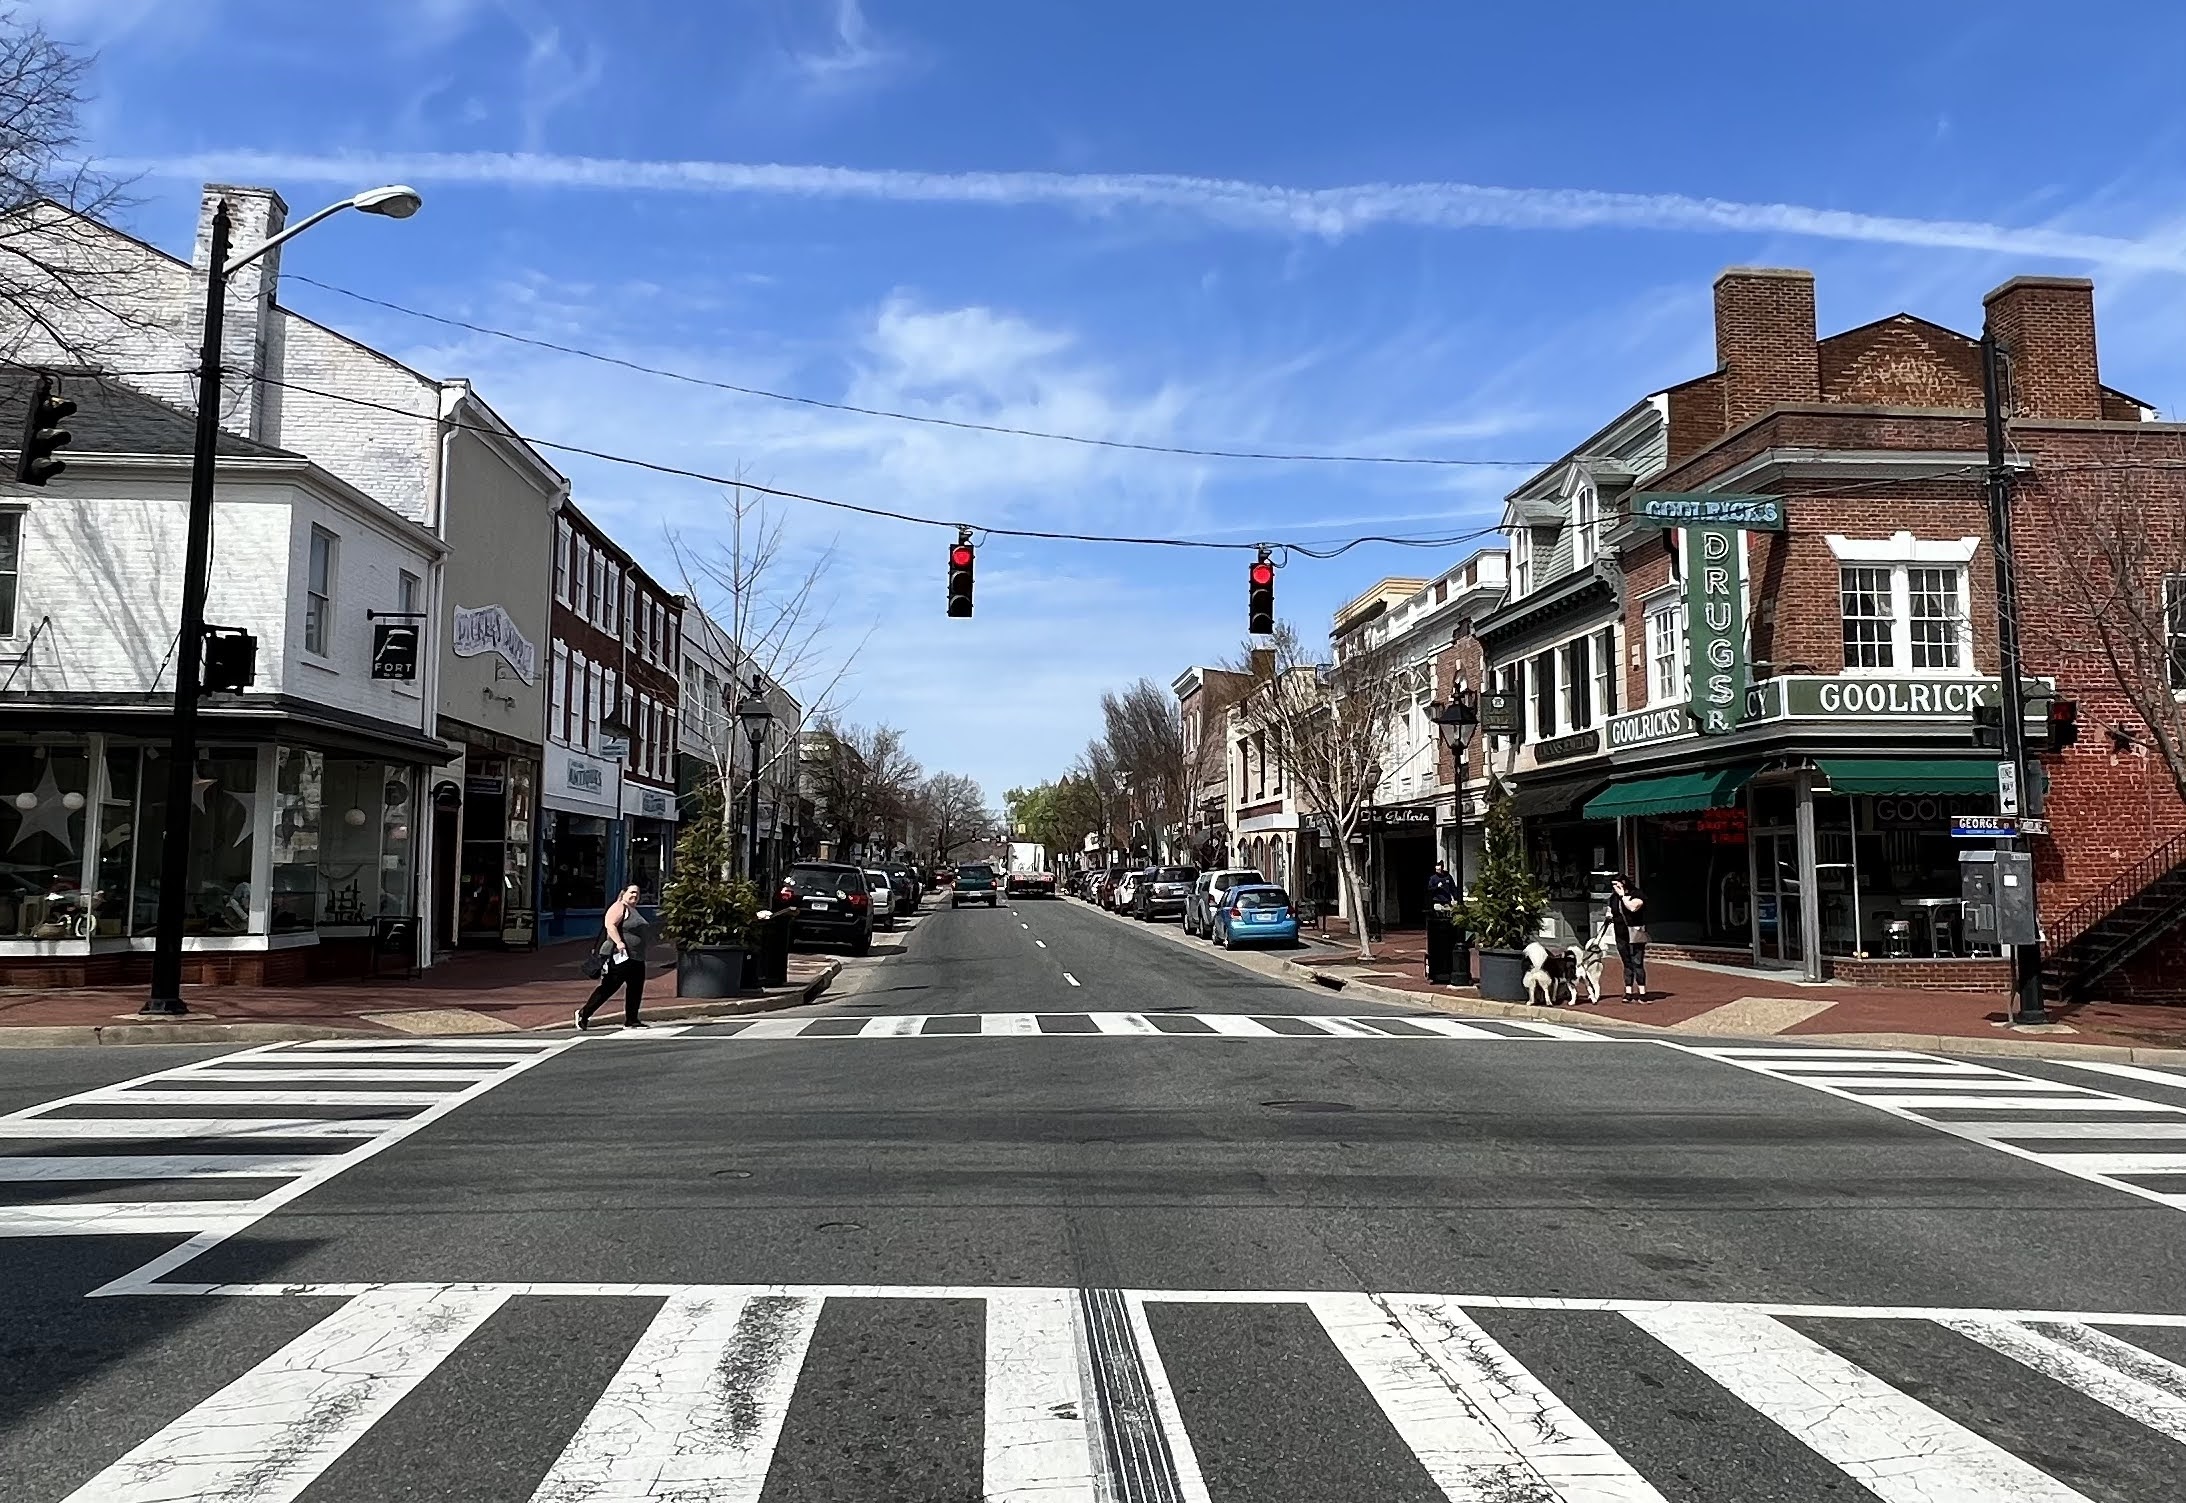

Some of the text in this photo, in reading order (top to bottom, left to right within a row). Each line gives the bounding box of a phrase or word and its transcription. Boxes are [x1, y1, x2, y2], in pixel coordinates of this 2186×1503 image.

[1702, 531, 1735, 705] DRUGS
[374, 663, 412, 672] FORT
[1959, 818, 1999, 829] GEORGE
